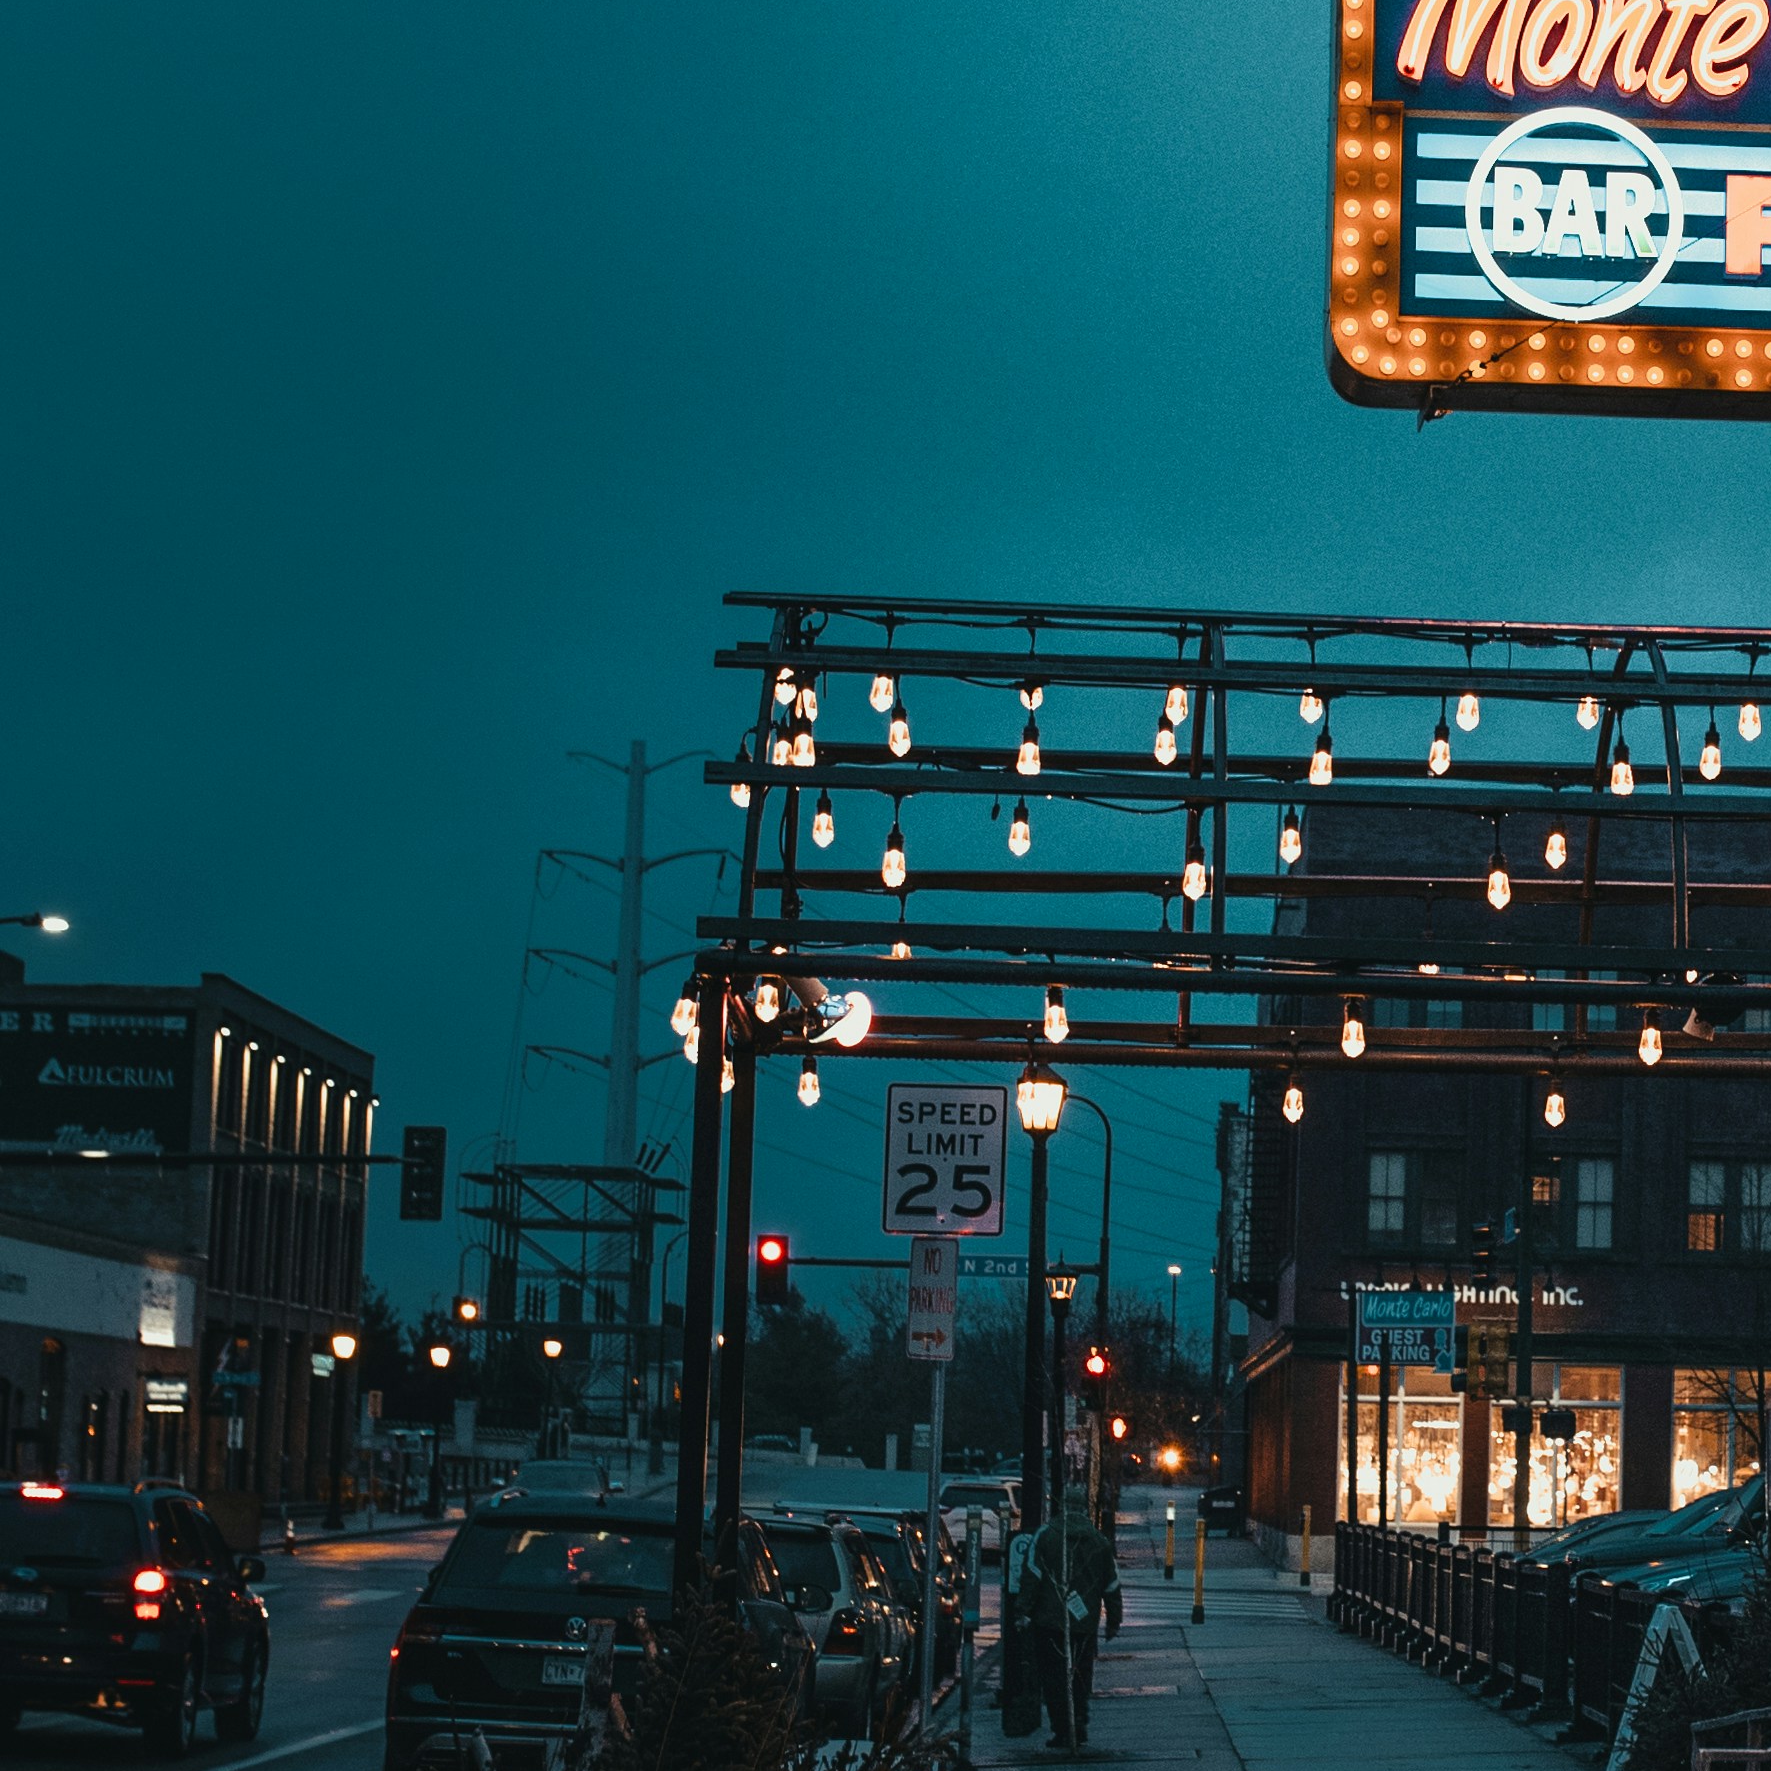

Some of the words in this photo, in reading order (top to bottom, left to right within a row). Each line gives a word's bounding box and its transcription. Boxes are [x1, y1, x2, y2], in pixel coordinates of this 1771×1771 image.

[1492, 166, 1660, 261] BAR
[67, 1064, 175, 1088] FULCRUM
[897, 1101, 997, 1126] SPEED
[907, 1132, 985, 1156] LIMIT
[895, 1163, 992, 1218] 25
[924, 1247, 942, 1275] NO
[964, 1259, 977, 1273] N
[983, 1259, 1018, 1275] 2nd
[909, 1286, 956, 1314] PARKING
[1365, 1295, 1410, 1320] Monte
[1413, 1296, 1451, 1319] Carlo
[1362, 1345, 1430, 1361] PAKING
